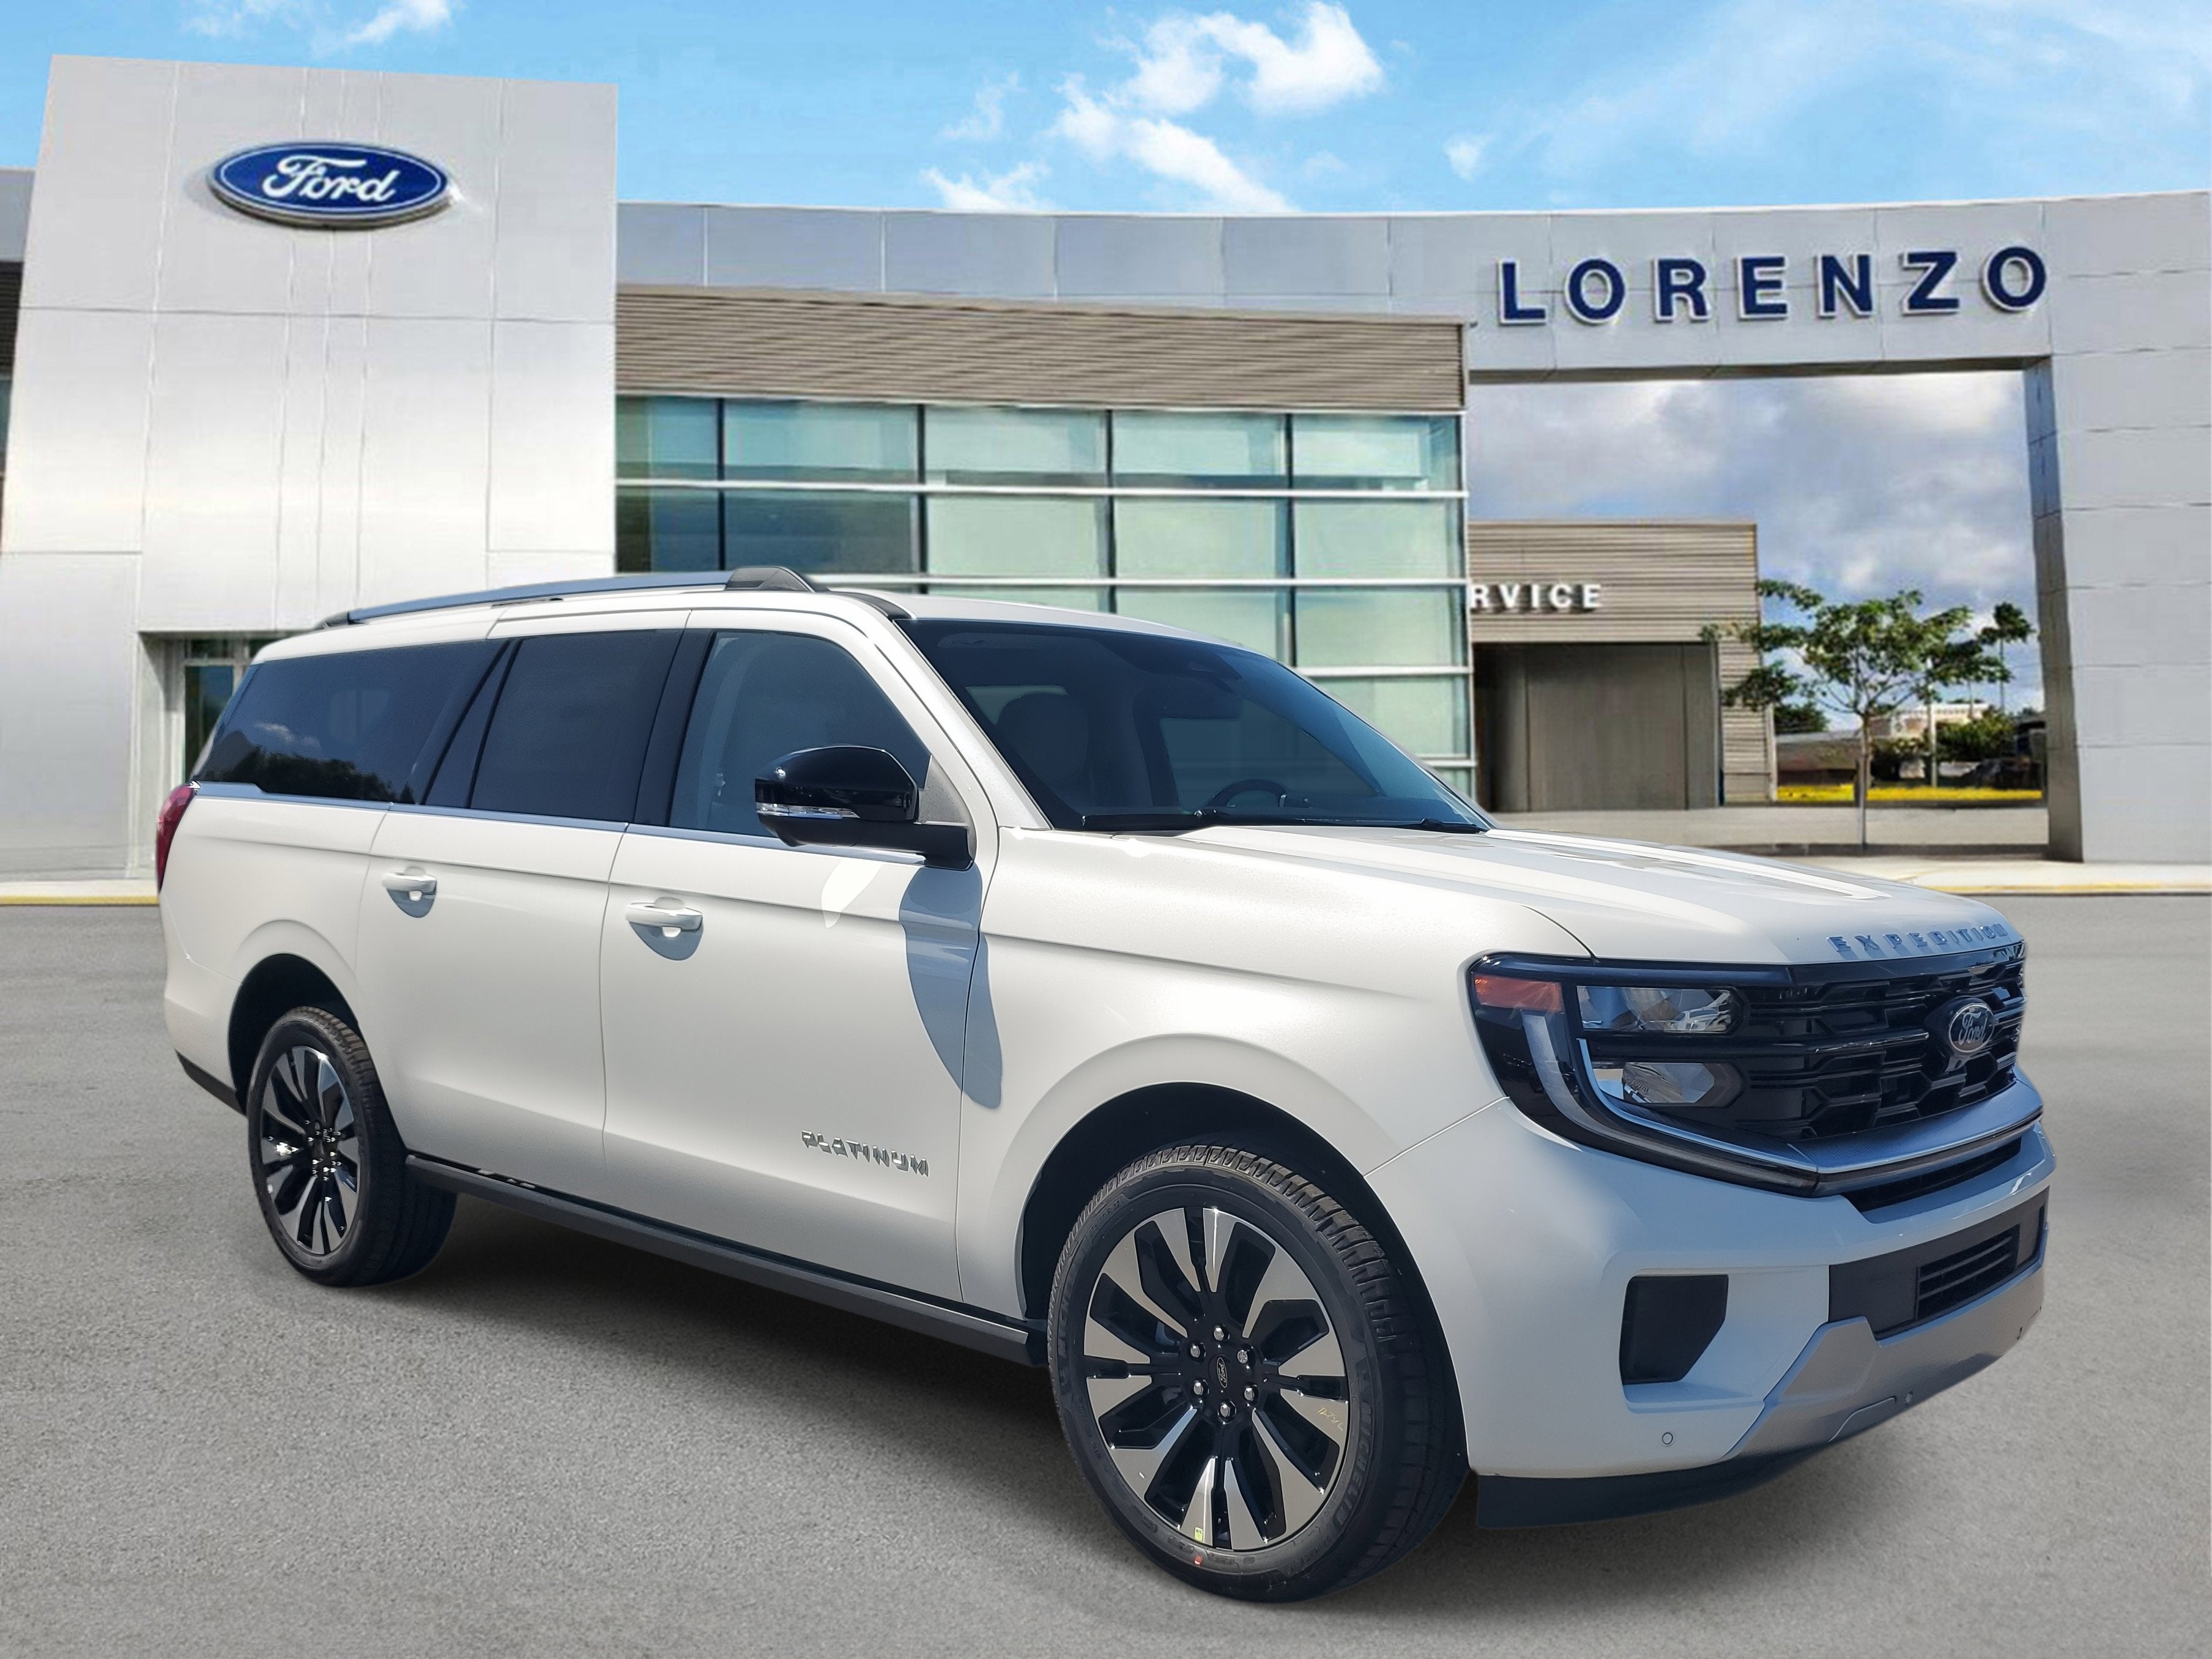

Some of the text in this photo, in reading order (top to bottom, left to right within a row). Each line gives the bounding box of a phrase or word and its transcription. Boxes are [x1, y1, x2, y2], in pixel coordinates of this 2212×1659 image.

[262, 155, 400, 202] Ford
[1498, 246, 2046, 325] LORENZO
[1826, 923, 2008, 952] EXPEDITION
[1958, 1011, 1988, 1045] Ford
[801, 1130, 929, 1177] PLATINUM
